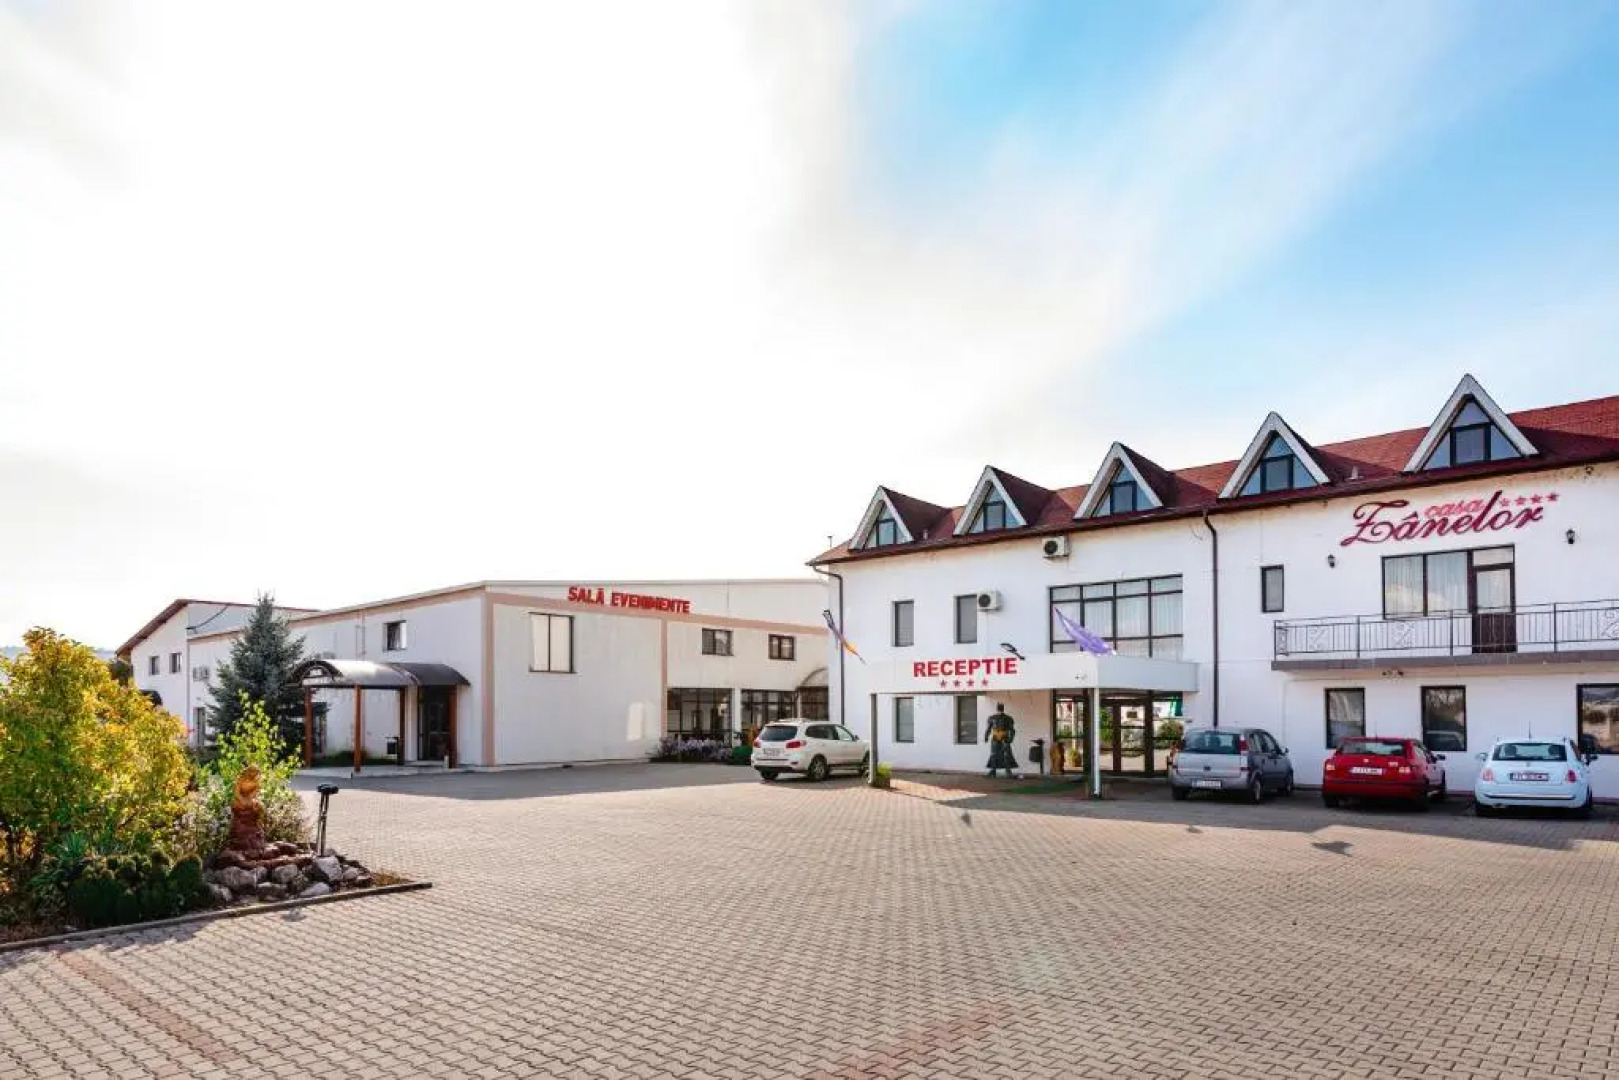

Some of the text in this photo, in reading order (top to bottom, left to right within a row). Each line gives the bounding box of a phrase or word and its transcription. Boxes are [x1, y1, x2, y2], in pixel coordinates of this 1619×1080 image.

[1424, 499, 1486, 518] casa
[610, 592, 690, 614] EVENIMENTE
[913, 657, 1017, 677] RECEPTIE
